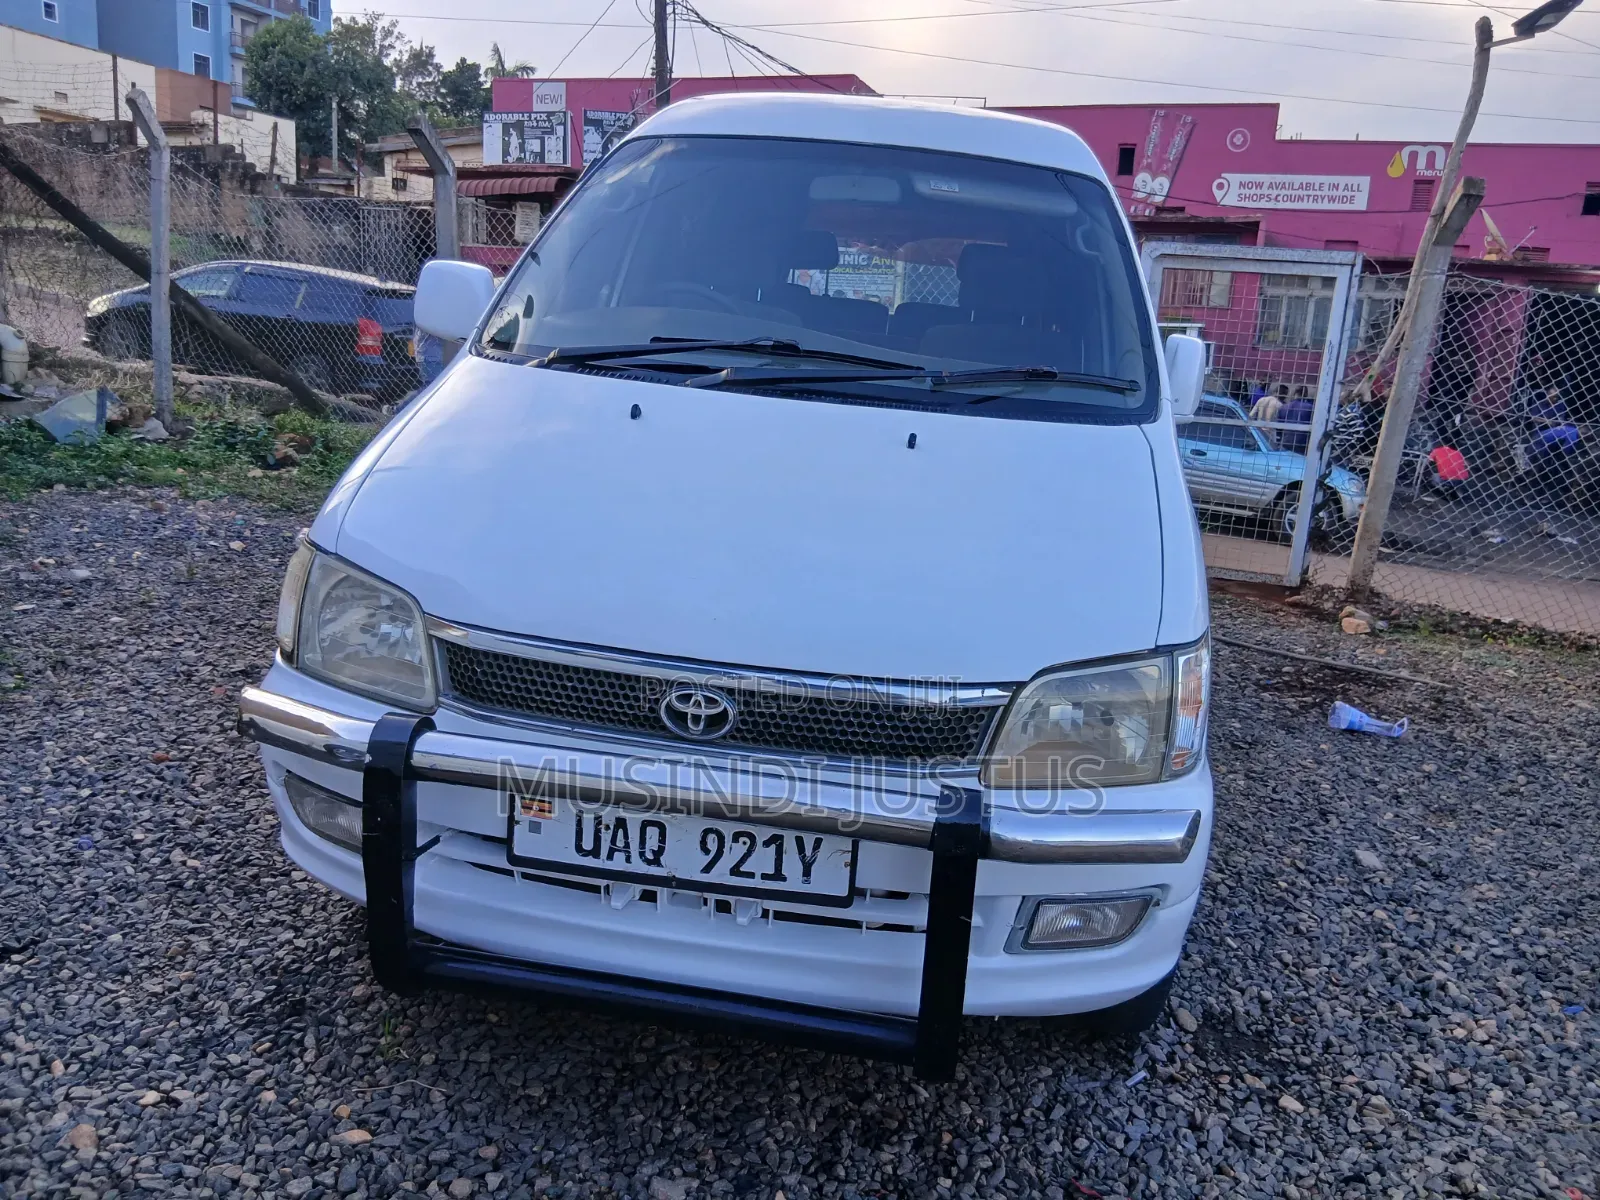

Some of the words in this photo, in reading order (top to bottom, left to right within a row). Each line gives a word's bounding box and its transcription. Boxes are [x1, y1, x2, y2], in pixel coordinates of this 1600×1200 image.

[536, 94, 562, 105] NEW!
[1238, 180, 1264, 190] NOW
[1267, 181, 1325, 192] AVAILABLE
[1328, 182, 1340, 192] IN
[1342, 183, 1363, 193] ALL
[1236, 193, 1271, 203] SHOPS
[1274, 193, 1356, 205] COUNTRYWIDE
[838, 254, 868, 266] INIC
[574, 808, 667, 868] UAQ
[699, 827, 824, 885] 921Y
